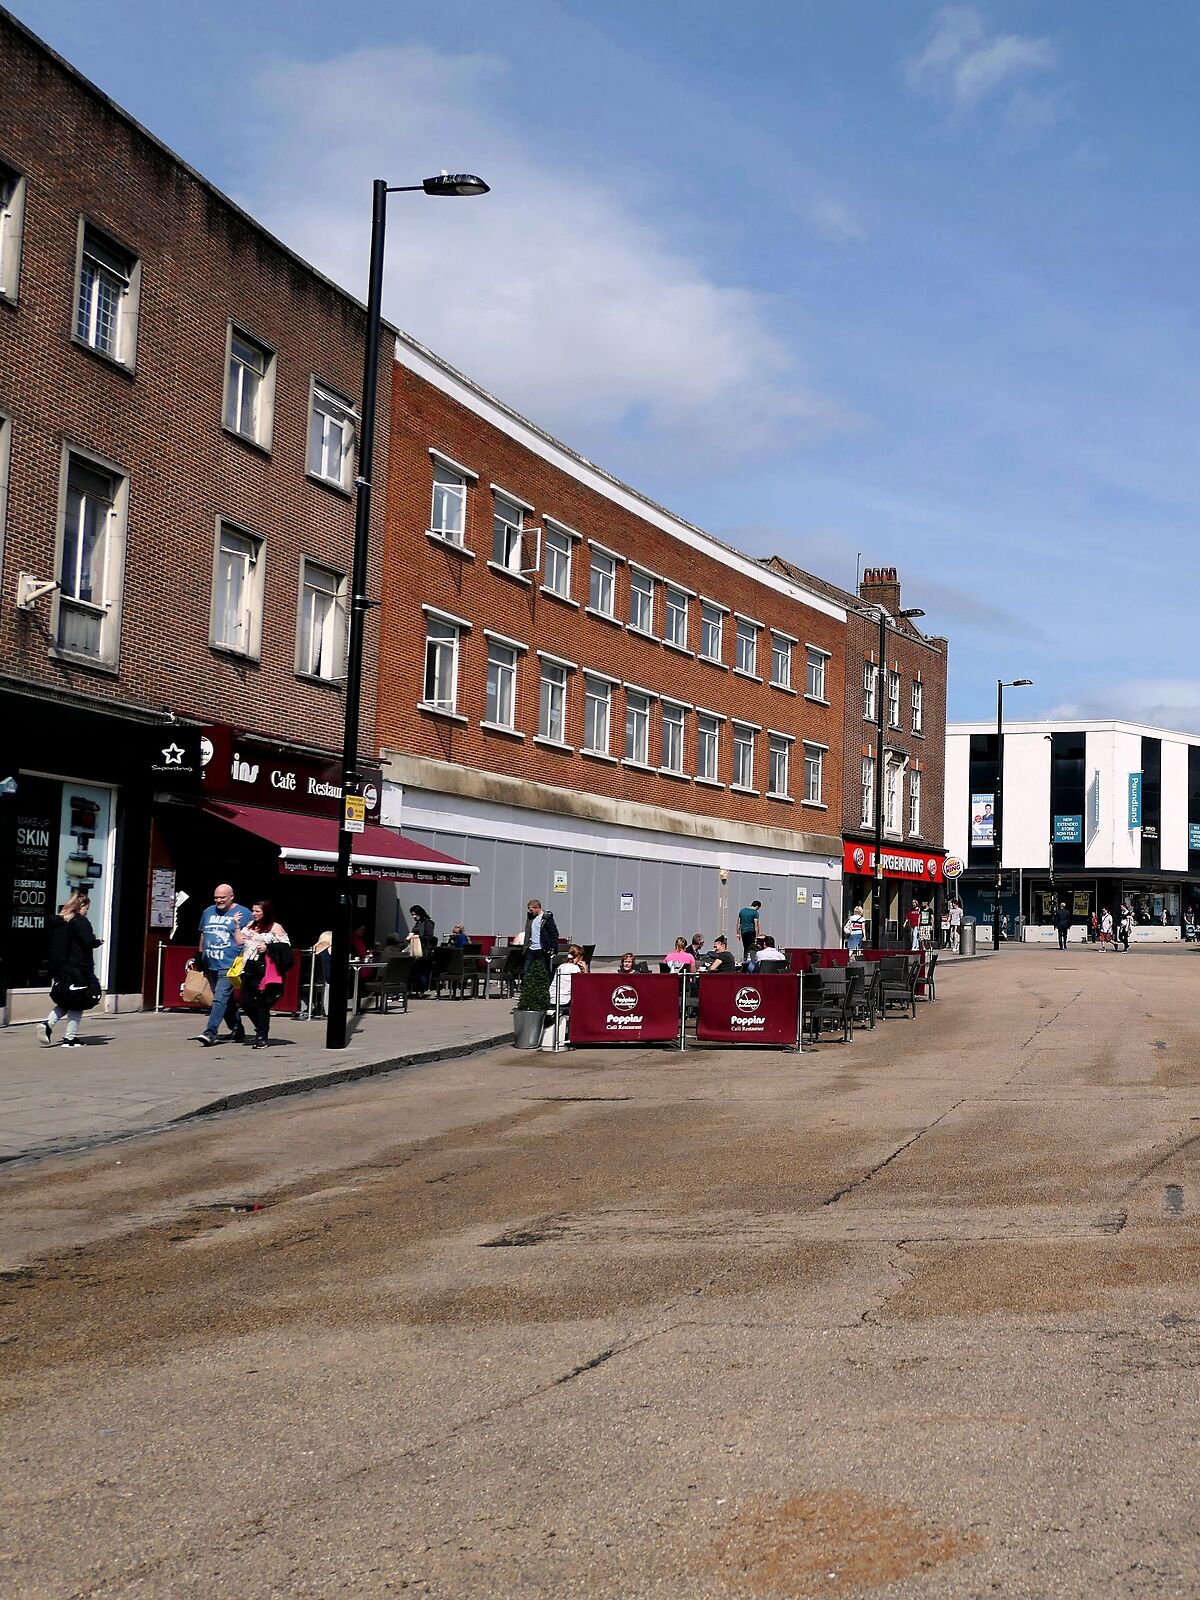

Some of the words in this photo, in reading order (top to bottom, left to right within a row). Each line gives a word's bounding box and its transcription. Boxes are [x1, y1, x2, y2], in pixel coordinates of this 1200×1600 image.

[151, 764, 193, 772] Superdrug
[271, 771, 296, 790] Café
[1131, 777, 1139, 823] Poundland
[17, 828, 49, 846] SKIN
[284, 861, 308, 872] Baguettes
[382, 869, 396, 878] Service
[396, 870, 414, 879] Available
[904, 858, 924, 874] KING
[946, 865, 961, 873] KING
[14, 880, 46, 889] ESSENTIALS
[13, 890, 46, 905] FOOD
[12, 916, 44, 928] HEALTH
[209, 915, 234, 924] DAD'S
[606, 1013, 643, 1025] Poppins
[731, 1015, 766, 1026] Poppins
